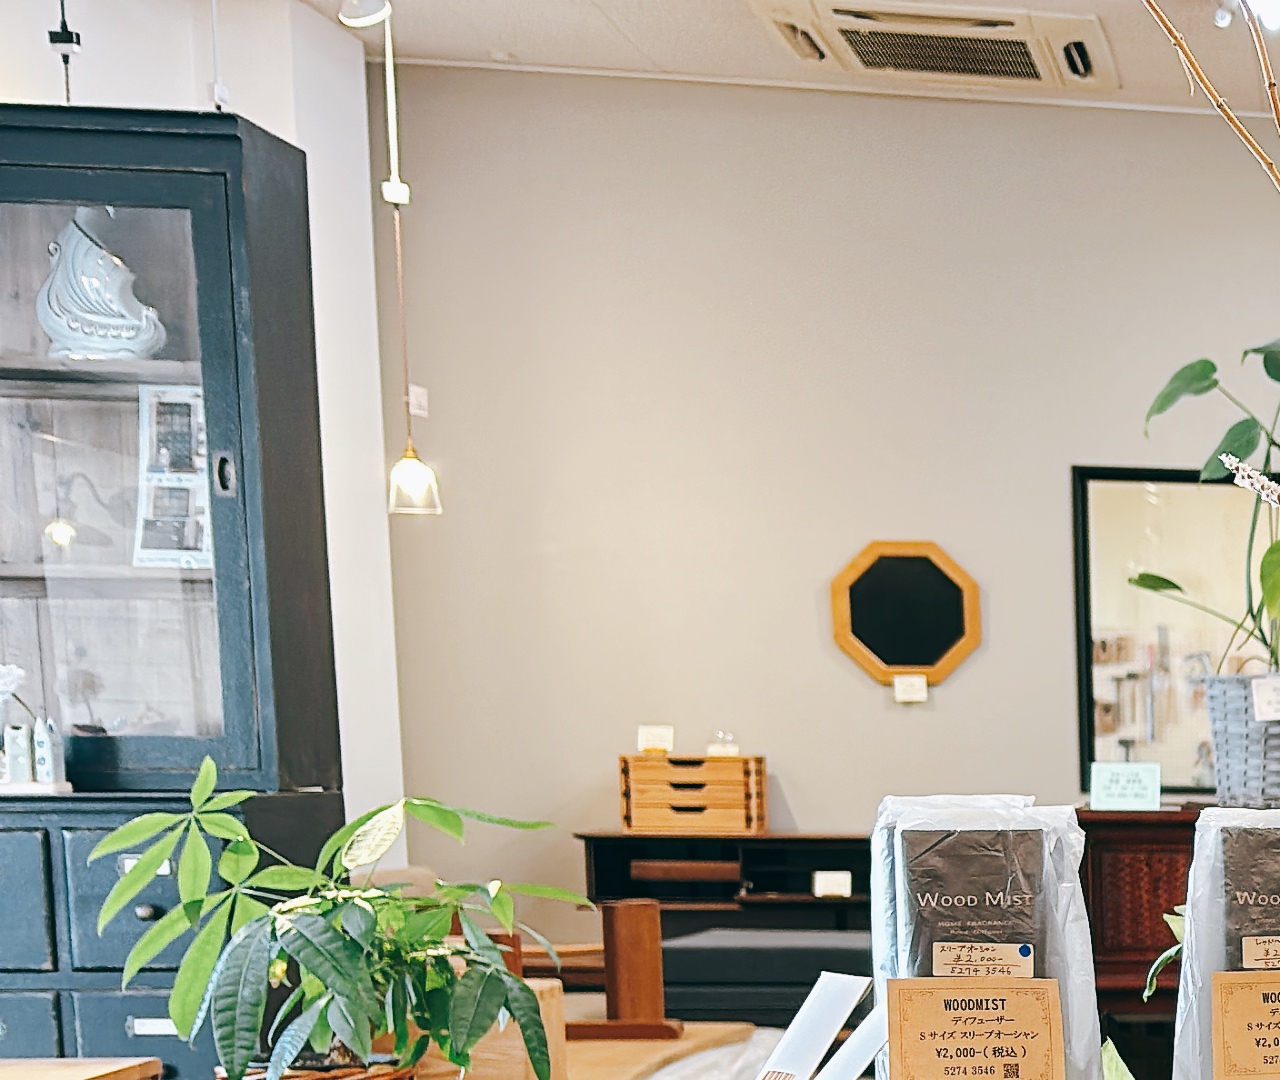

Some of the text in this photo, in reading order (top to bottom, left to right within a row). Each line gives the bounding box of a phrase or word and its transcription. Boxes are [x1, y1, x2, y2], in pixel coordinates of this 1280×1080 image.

[944, 998, 1006, 1012] WOODMIST
[951, 1016, 1015, 1026] ディフューザー
[961, 1029, 1039, 1040] スリープオーシャン
[944, 1065, 995, 1076] 5274 3546
